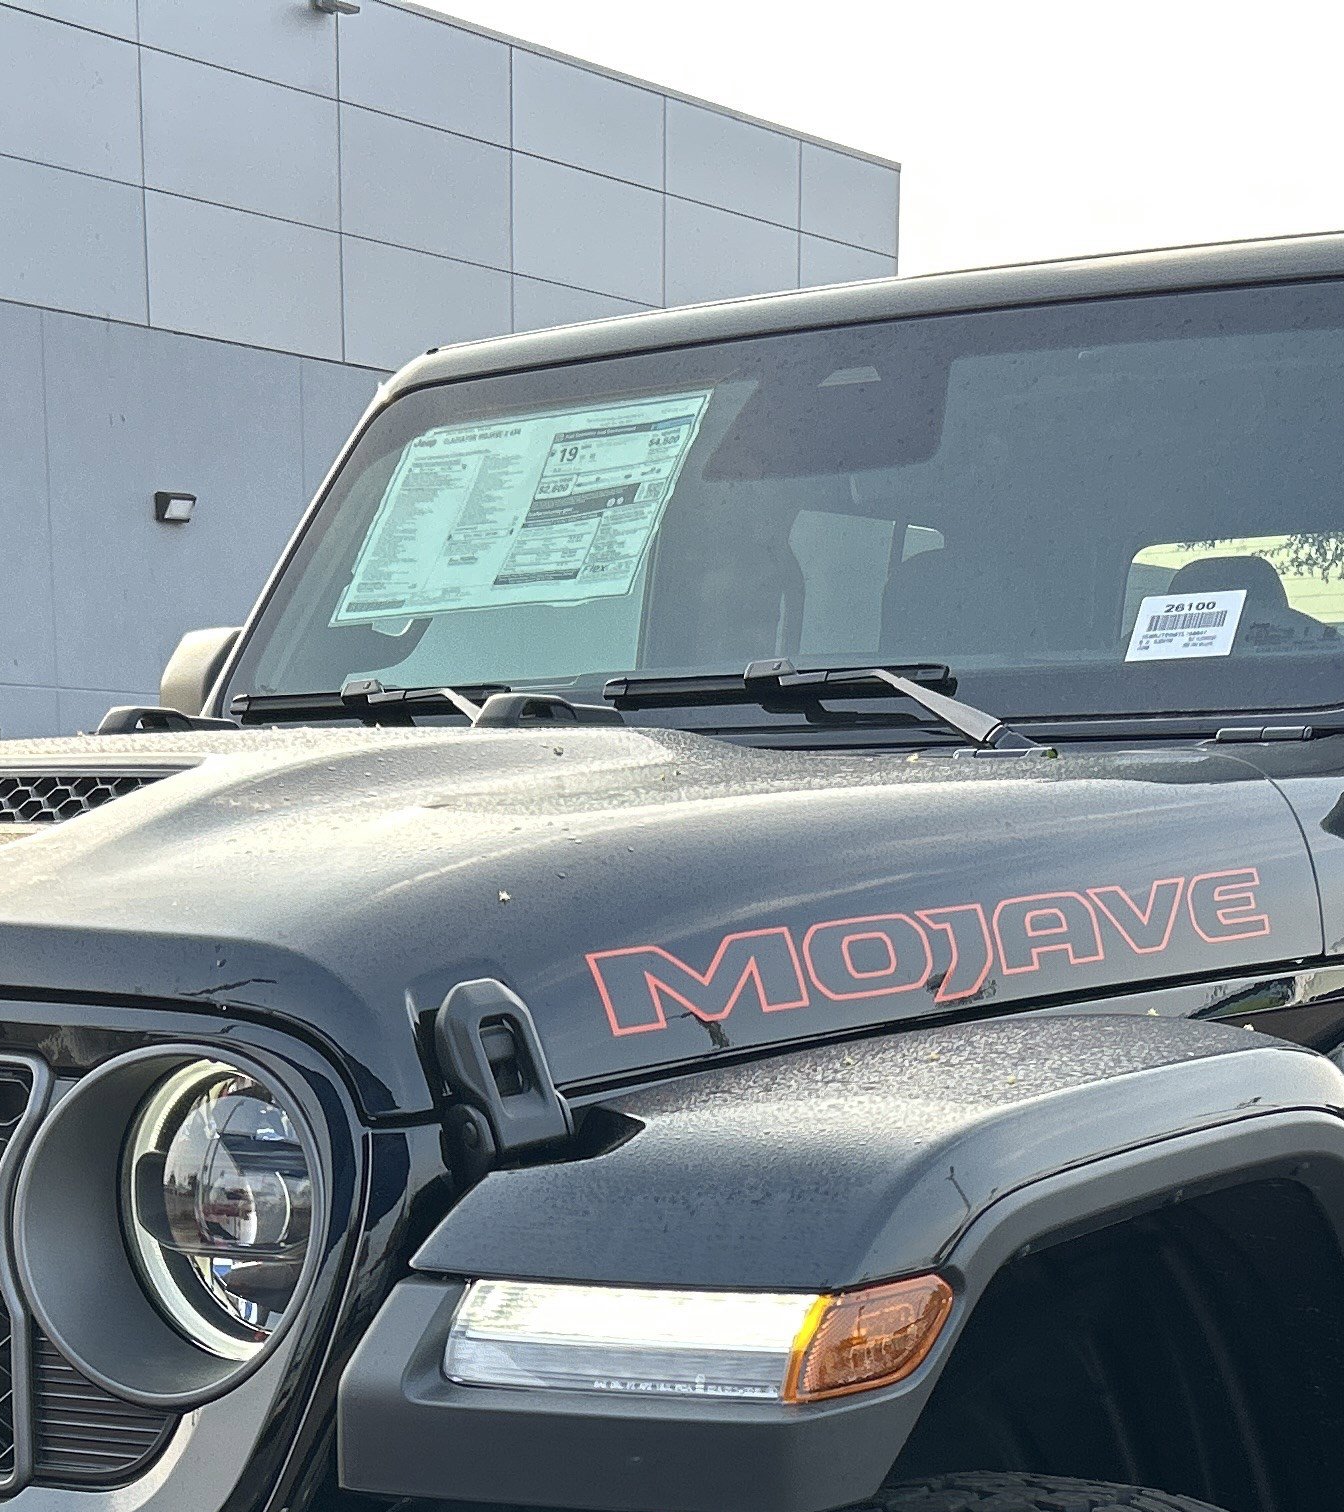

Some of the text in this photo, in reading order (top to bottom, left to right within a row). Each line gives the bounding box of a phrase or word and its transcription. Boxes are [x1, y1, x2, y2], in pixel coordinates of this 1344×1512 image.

[559, 446, 579, 463] 19
[1164, 601, 1217, 613] 26100
[585, 868, 1270, 1037] MOJAVE
